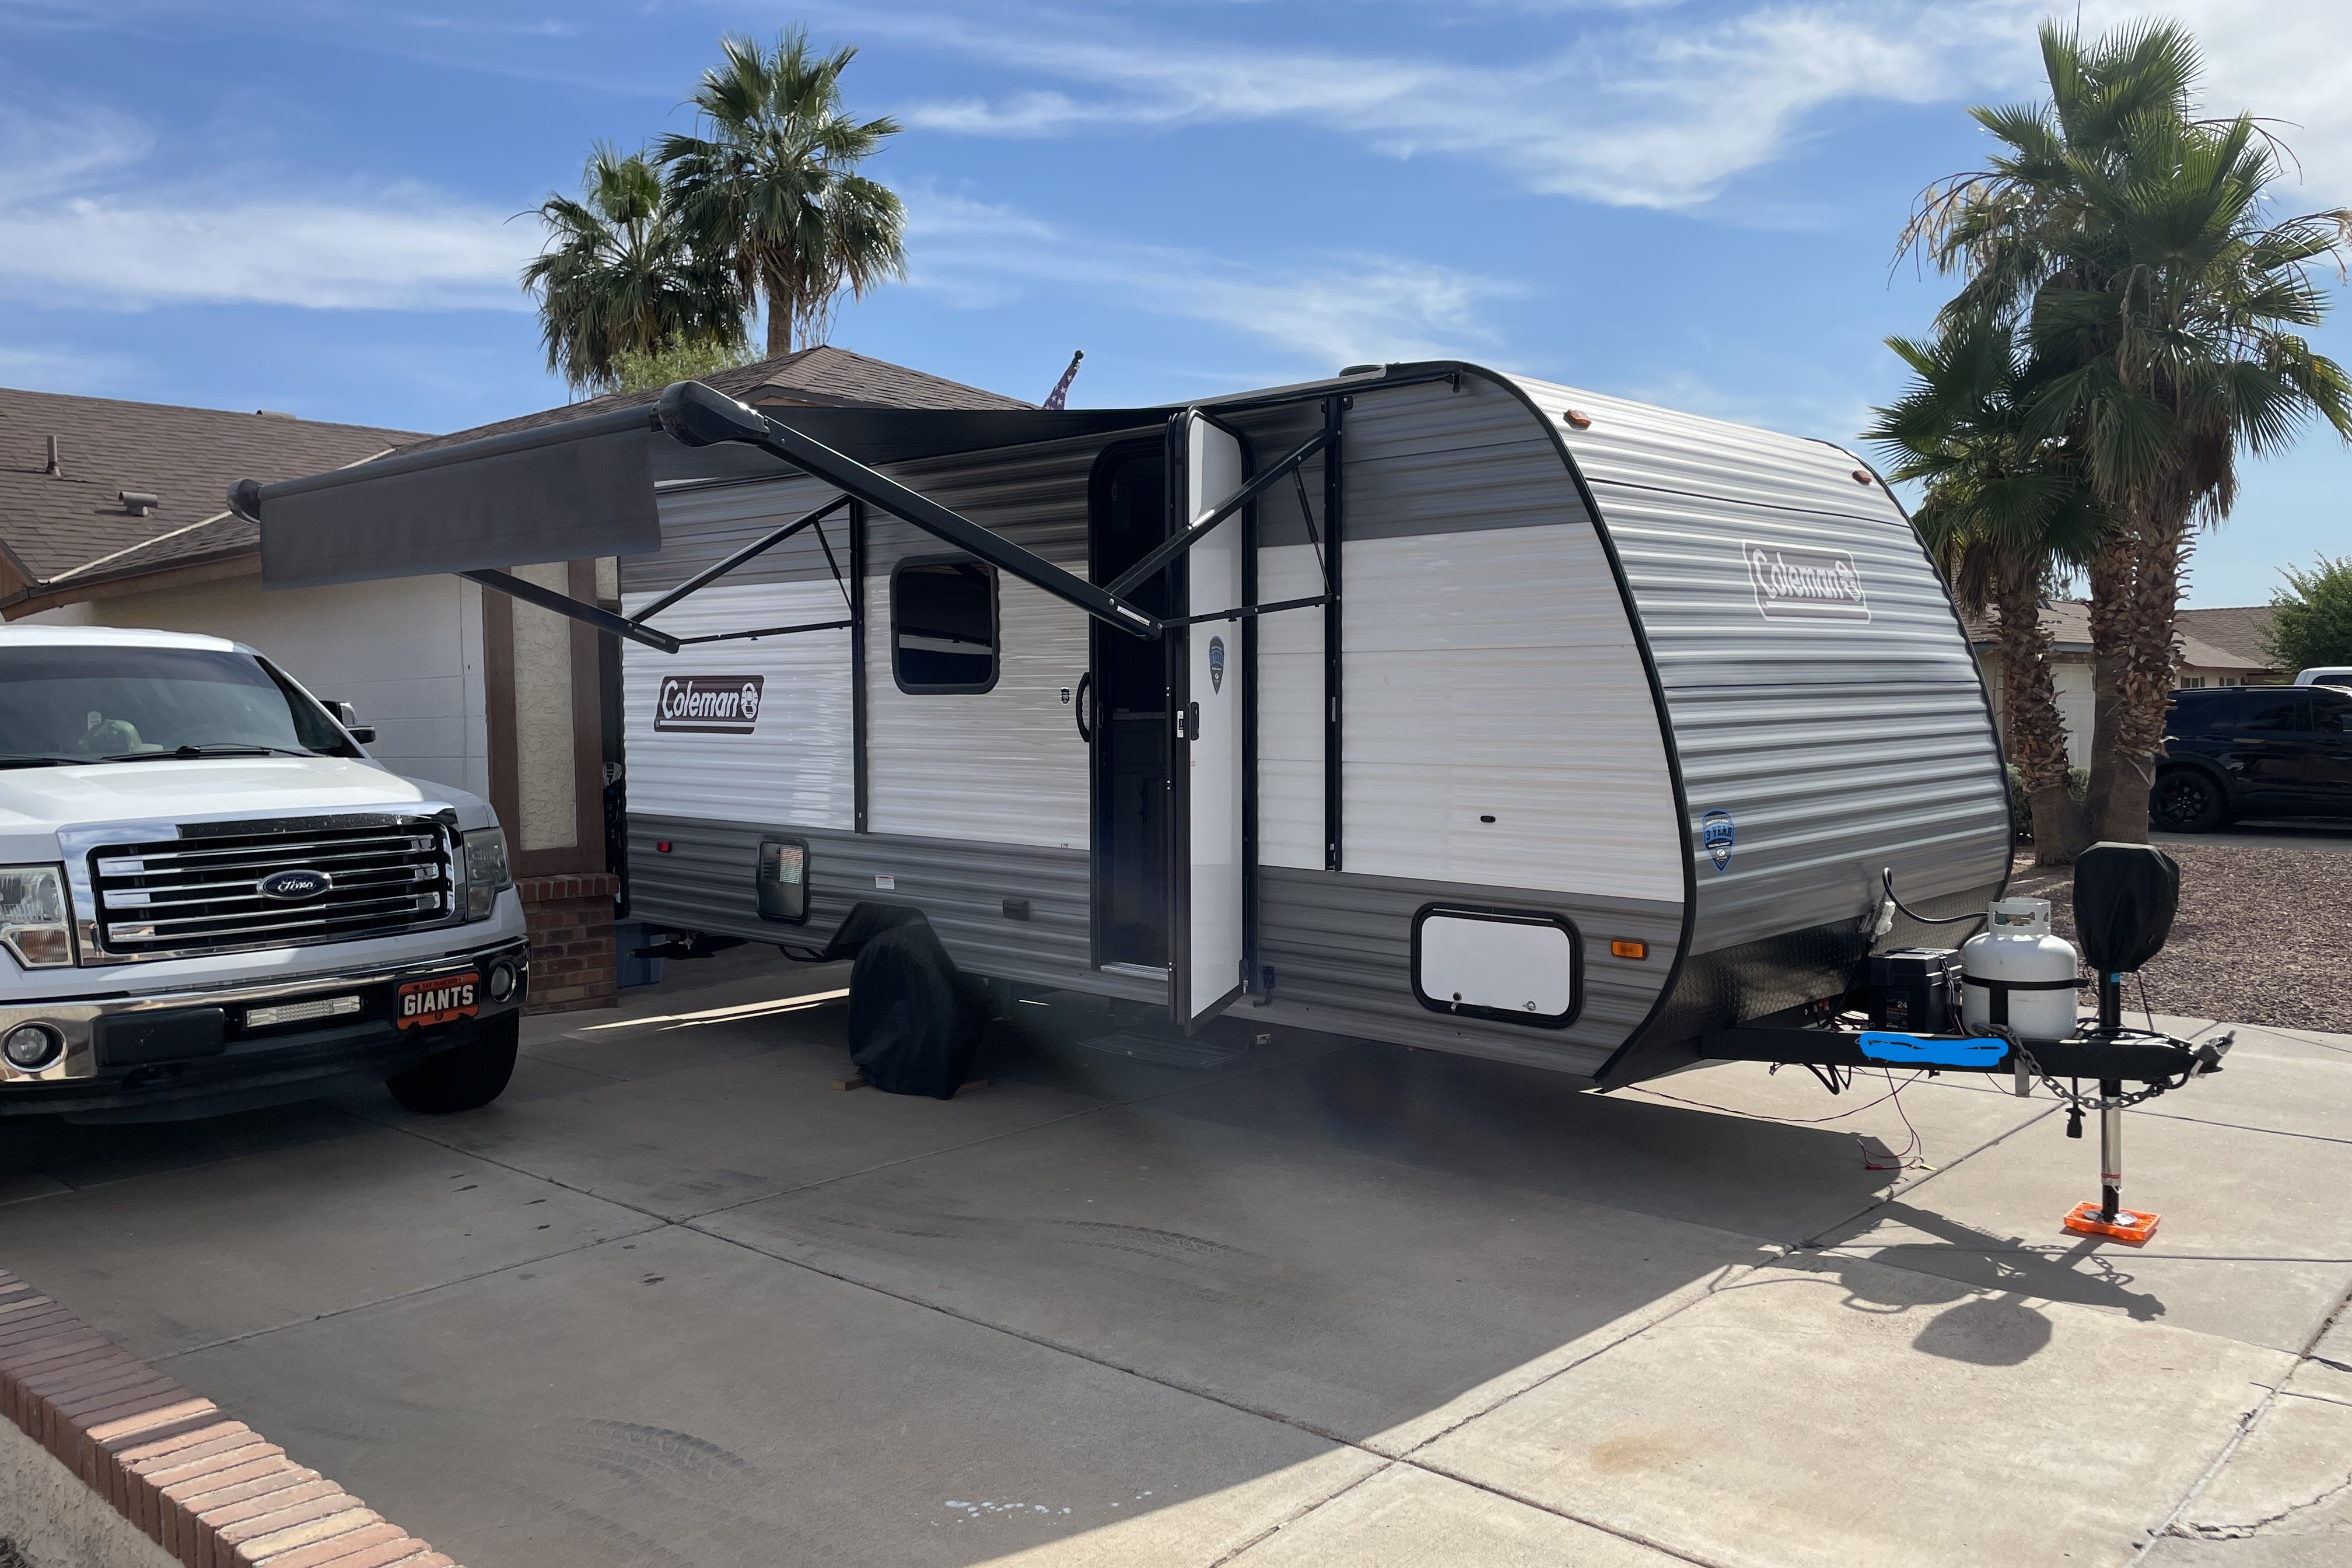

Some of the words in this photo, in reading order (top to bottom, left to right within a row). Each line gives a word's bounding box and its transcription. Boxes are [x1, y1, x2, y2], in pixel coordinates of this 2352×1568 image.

[1752, 548, 1844, 599] Coleman
[662, 680, 740, 719] Coleman
[1712, 825, 1732, 838] YEAR
[278, 878, 317, 892] Ford
[404, 984, 474, 1016] GIANTS
